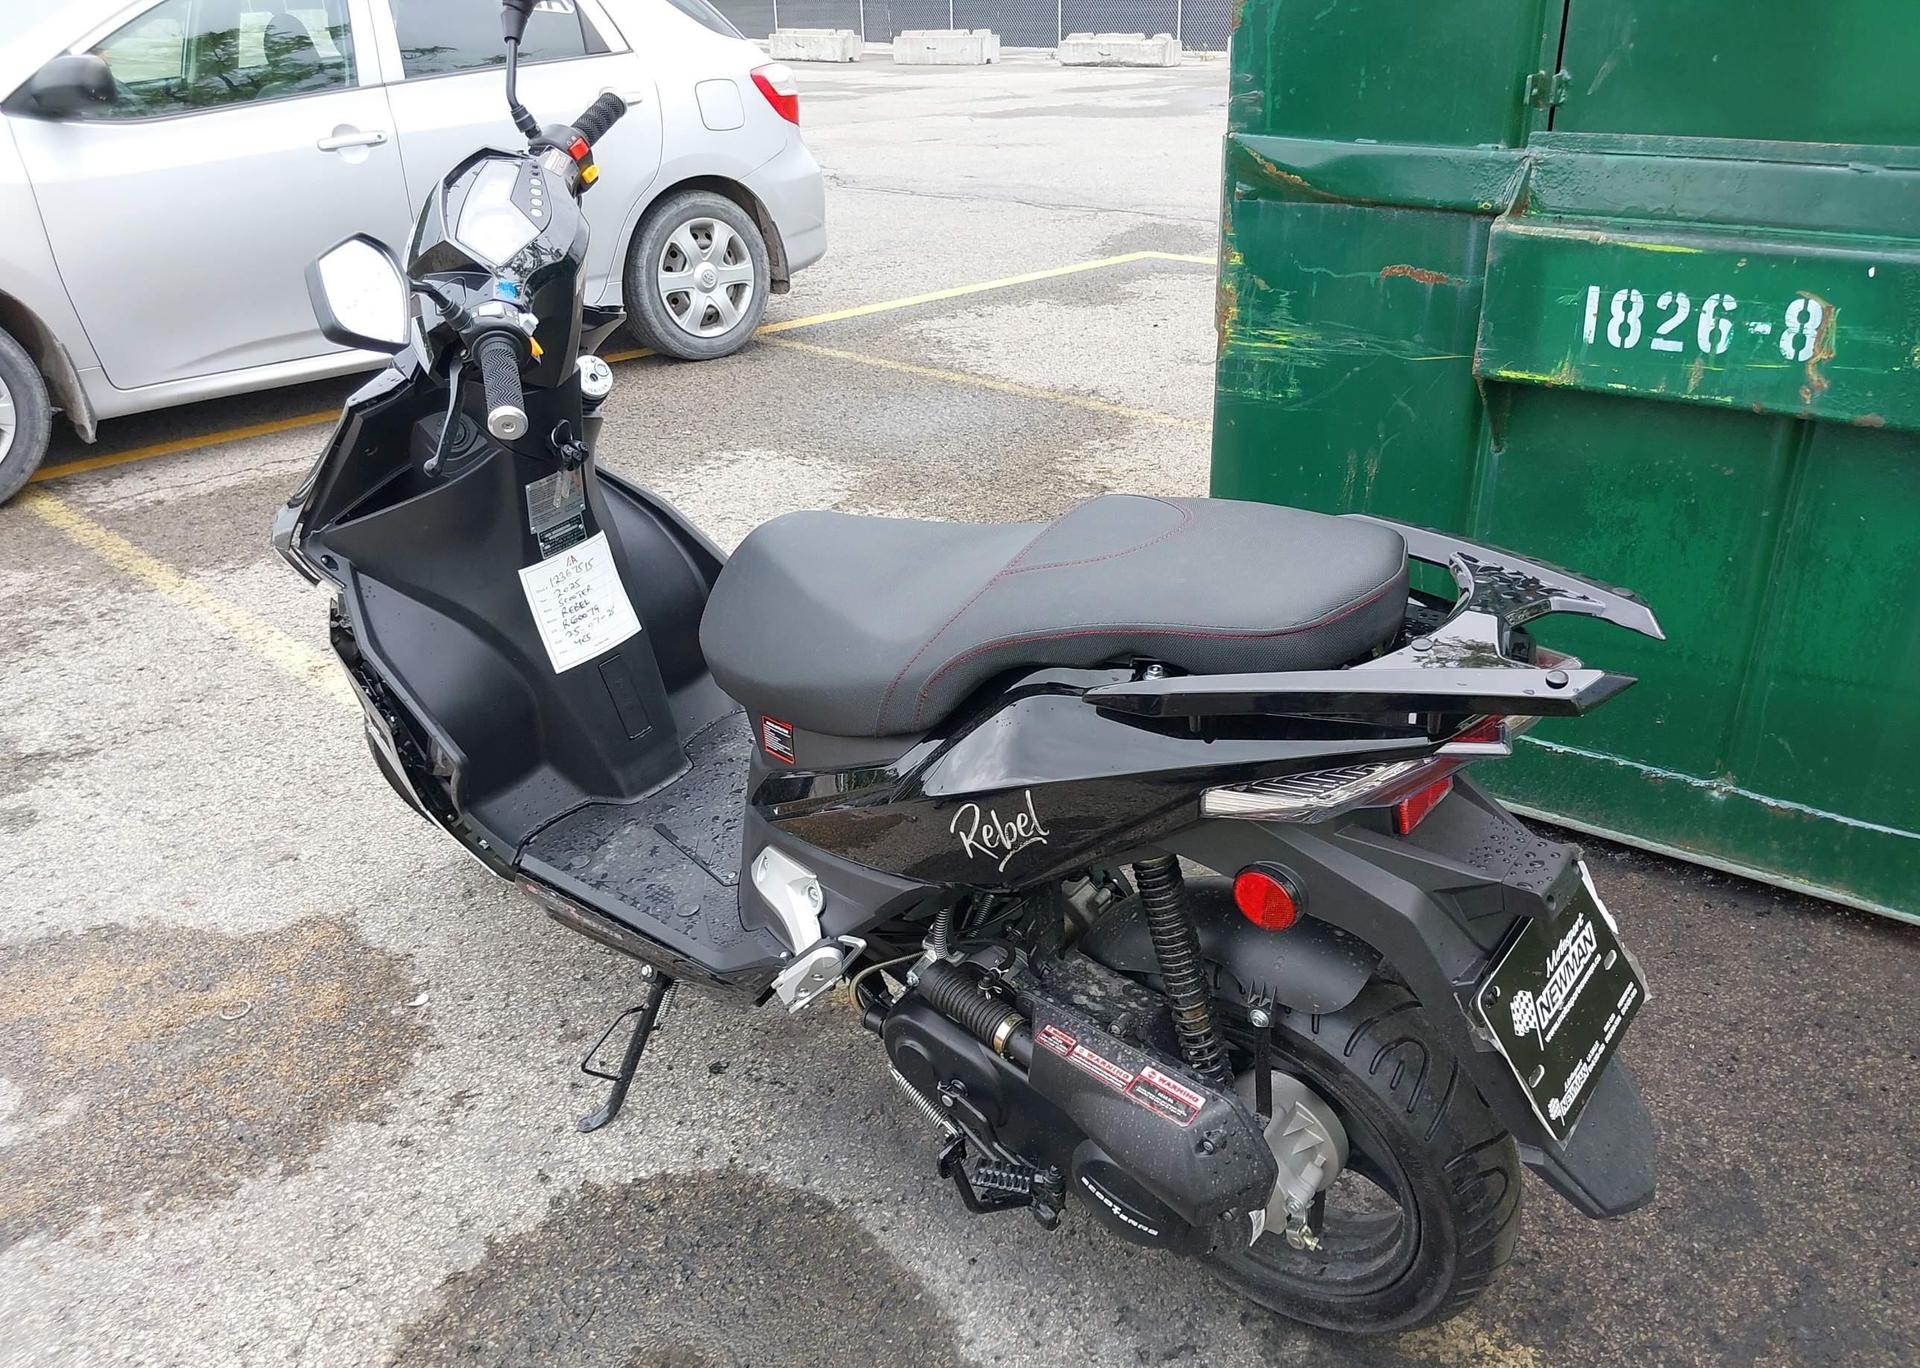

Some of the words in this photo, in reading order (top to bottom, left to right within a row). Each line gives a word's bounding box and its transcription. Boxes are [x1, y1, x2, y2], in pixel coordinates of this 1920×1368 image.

[1583, 286, 1822, 361] 1826-8
[553, 579, 581, 598] 2025
[558, 584, 593, 607] SCOOTER
[561, 600, 590, 618] REBEL
[950, 789, 1049, 862] Rebel
[1546, 912, 1584, 978] Motosport
[1537, 920, 1597, 1030] NEWMAN
[1087, 1053, 1130, 1079] WARNING
[1159, 1076, 1199, 1102] WARNING
